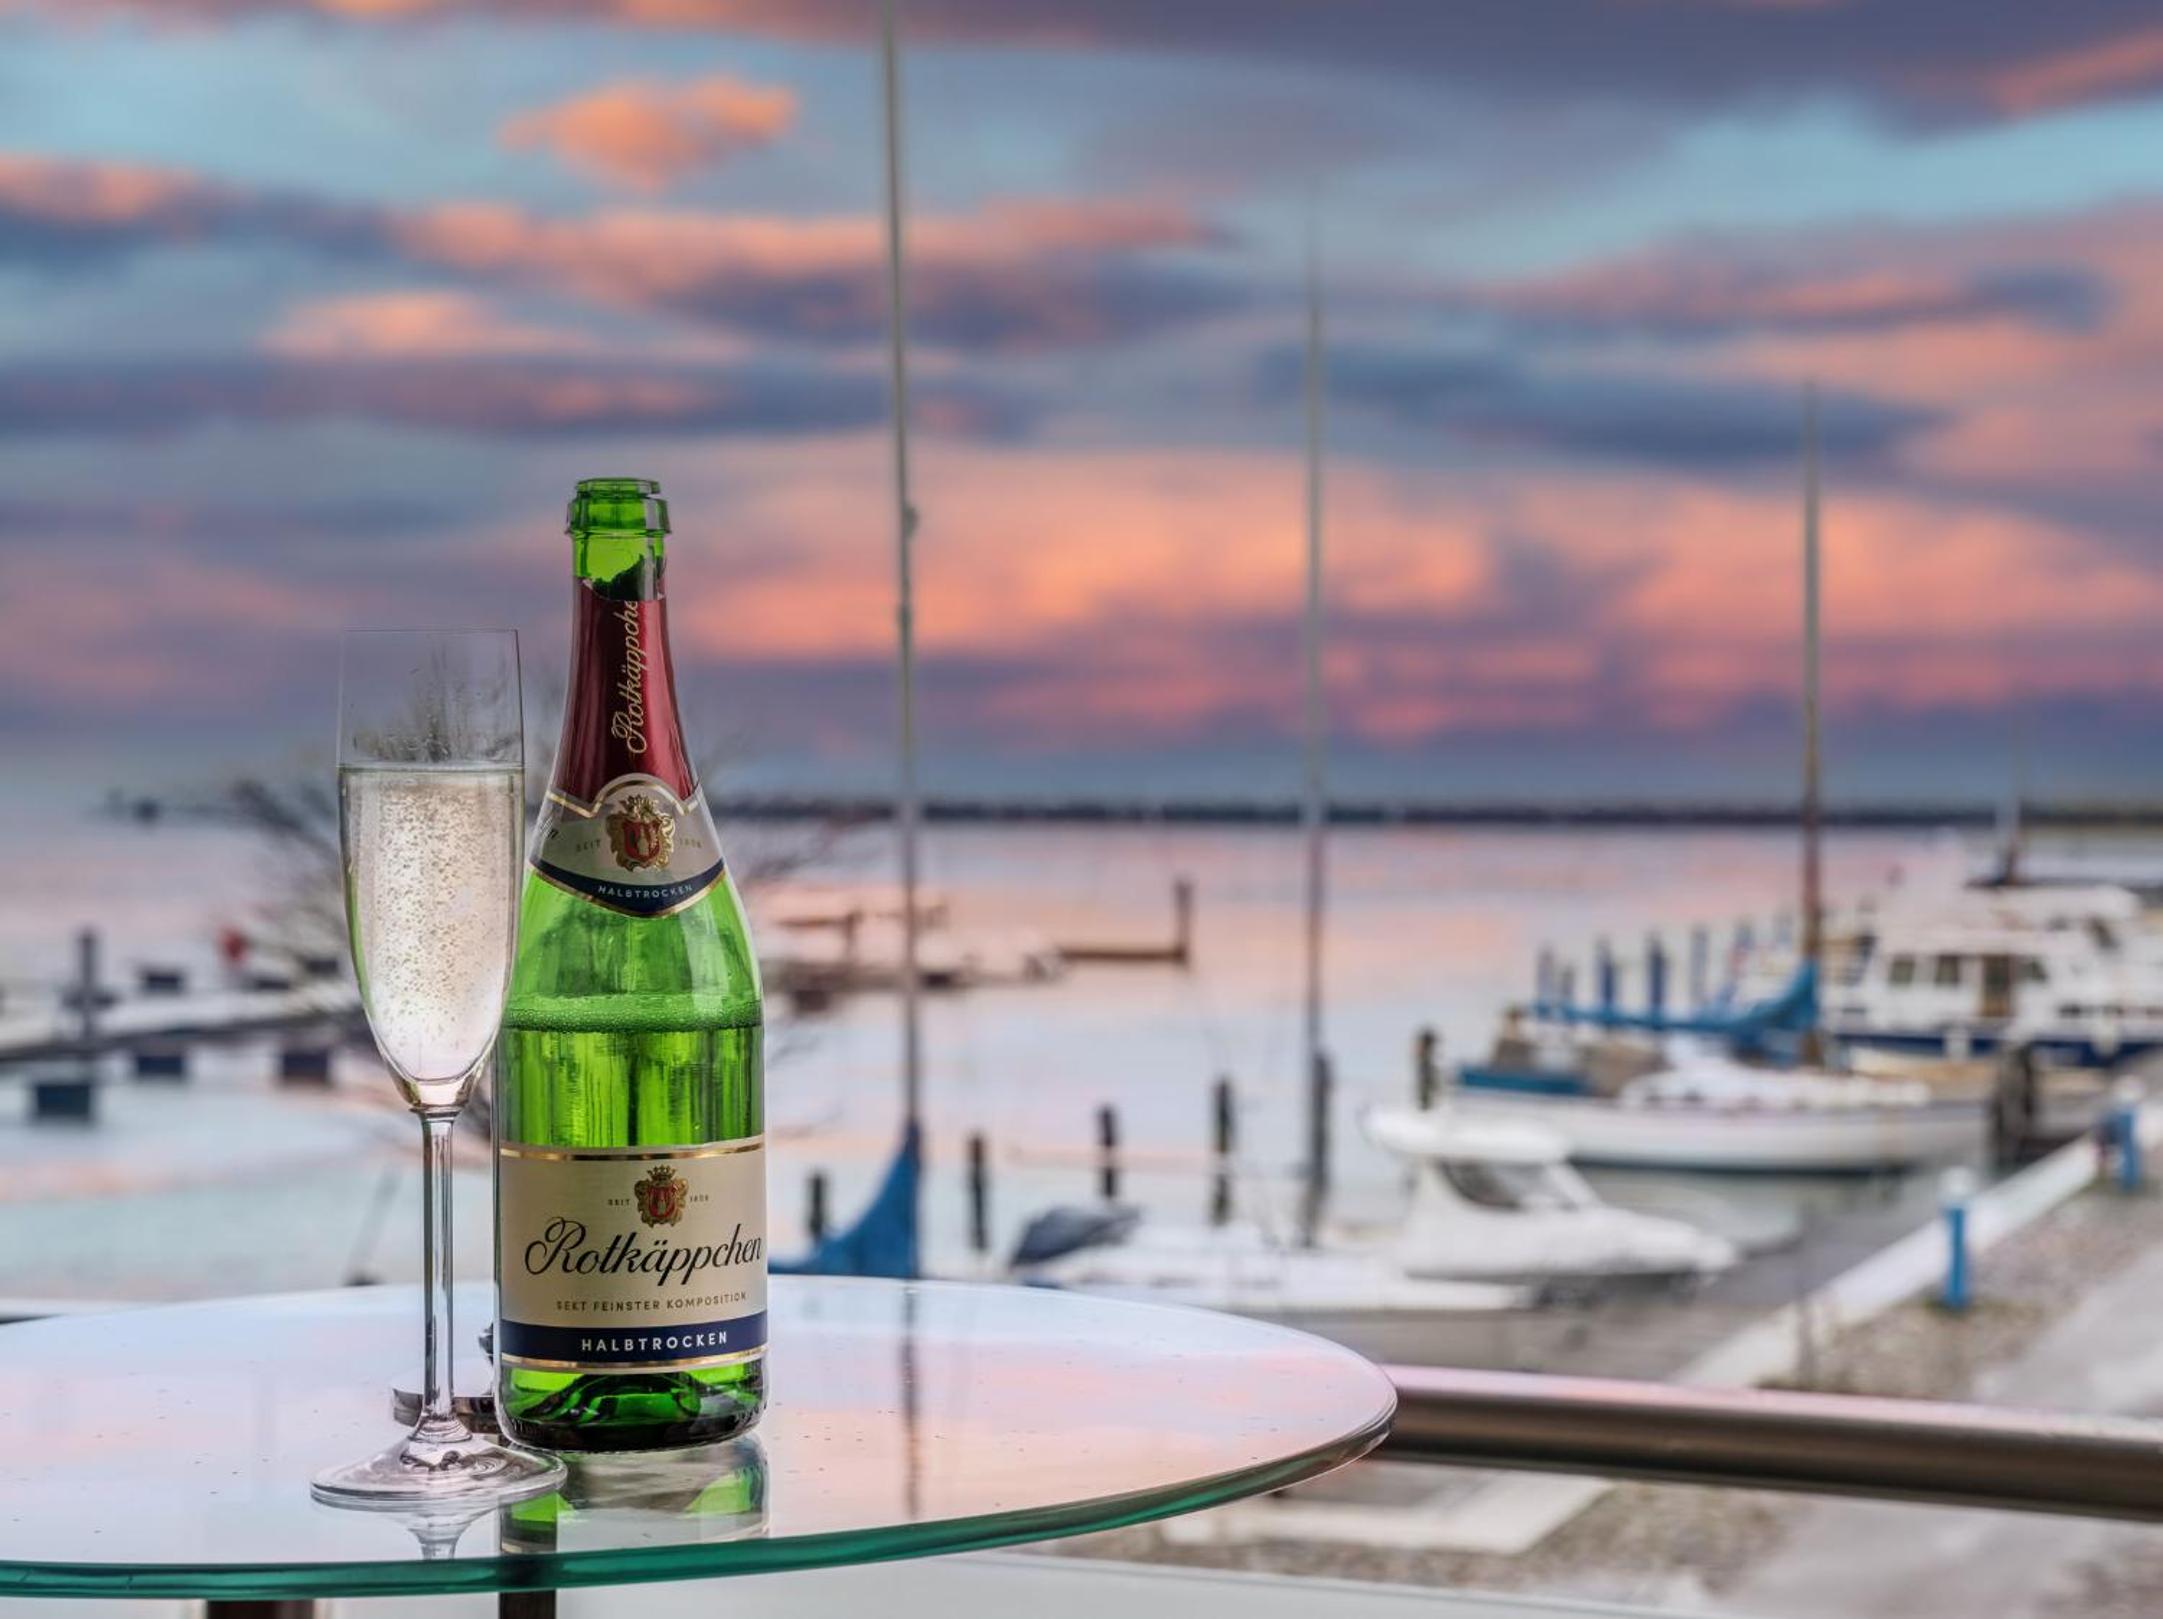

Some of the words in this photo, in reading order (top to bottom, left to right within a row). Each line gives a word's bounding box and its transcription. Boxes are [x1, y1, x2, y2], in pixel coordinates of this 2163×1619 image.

[611, 600, 647, 754] Rotkäppche
[597, 884, 693, 899] HALBTROCKEN
[607, 1198, 631, 1206] SEIT
[524, 1216, 762, 1287] Rotkäppchen
[556, 1301, 586, 1312] SEKT
[593, 1301, 660, 1312] FEINSTER
[667, 1291, 747, 1309] KOMPOSITION
[581, 1331, 728, 1352] HALBTROCKEN
